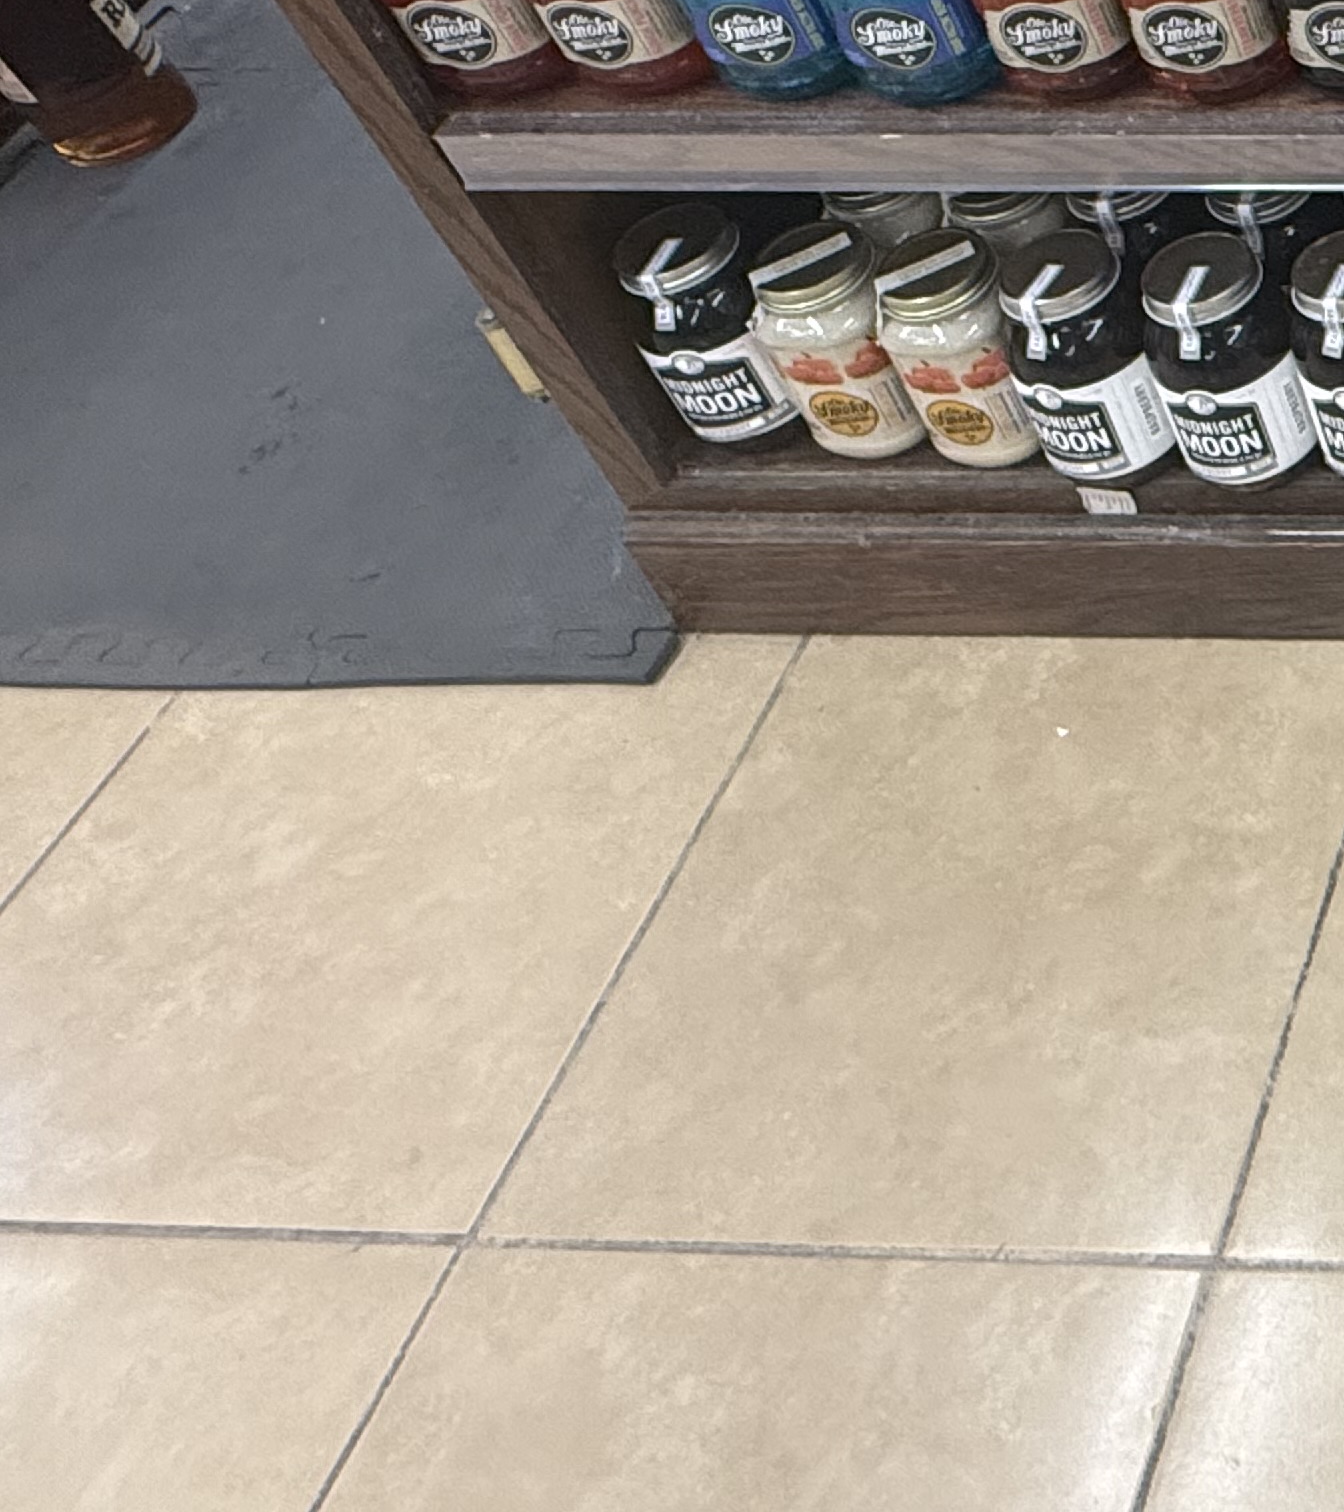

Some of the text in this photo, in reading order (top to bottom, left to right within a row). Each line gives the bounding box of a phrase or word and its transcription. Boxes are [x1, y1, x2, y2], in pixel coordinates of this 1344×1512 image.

[413, 19, 482, 43] Smoky
[552, 19, 618, 43] Smoky
[714, 17, 782, 43] Smoky
[857, 20, 925, 44] Smoky
[1005, 20, 1074, 44] Smoky
[1149, 20, 1218, 45] Smoky
[678, 384, 761, 415] MOON
[1183, 429, 1262, 456] MOON
